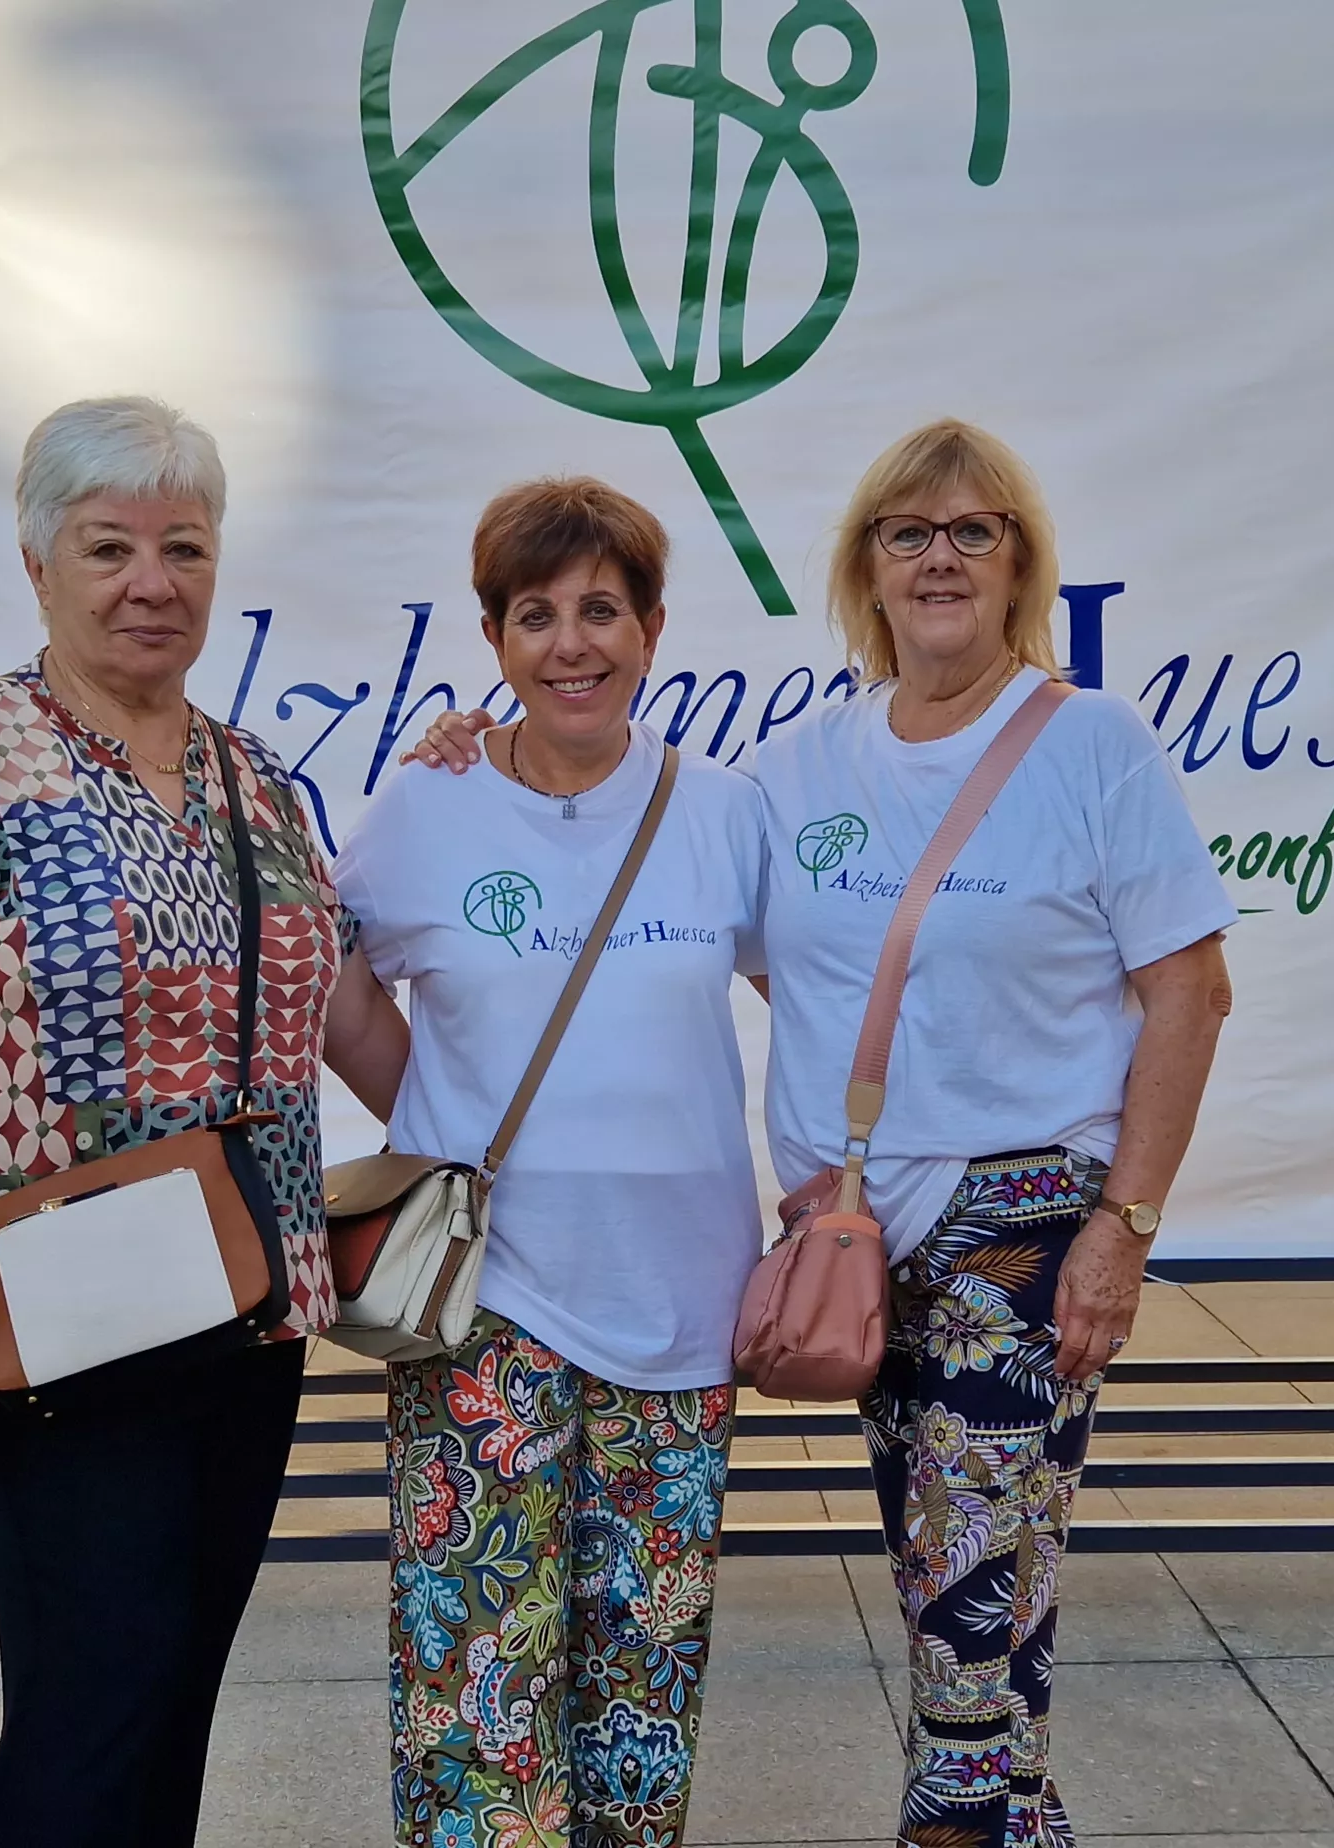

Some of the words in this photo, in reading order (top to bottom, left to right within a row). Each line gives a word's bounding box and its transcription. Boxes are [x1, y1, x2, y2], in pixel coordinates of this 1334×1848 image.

[227, 602, 889, 858] lzhme
[828, 868, 907, 902] Alzhei
[935, 870, 1007, 896] Huesca
[529, 926, 639, 961] Alzhmer
[641, 919, 717, 946] Huesca
